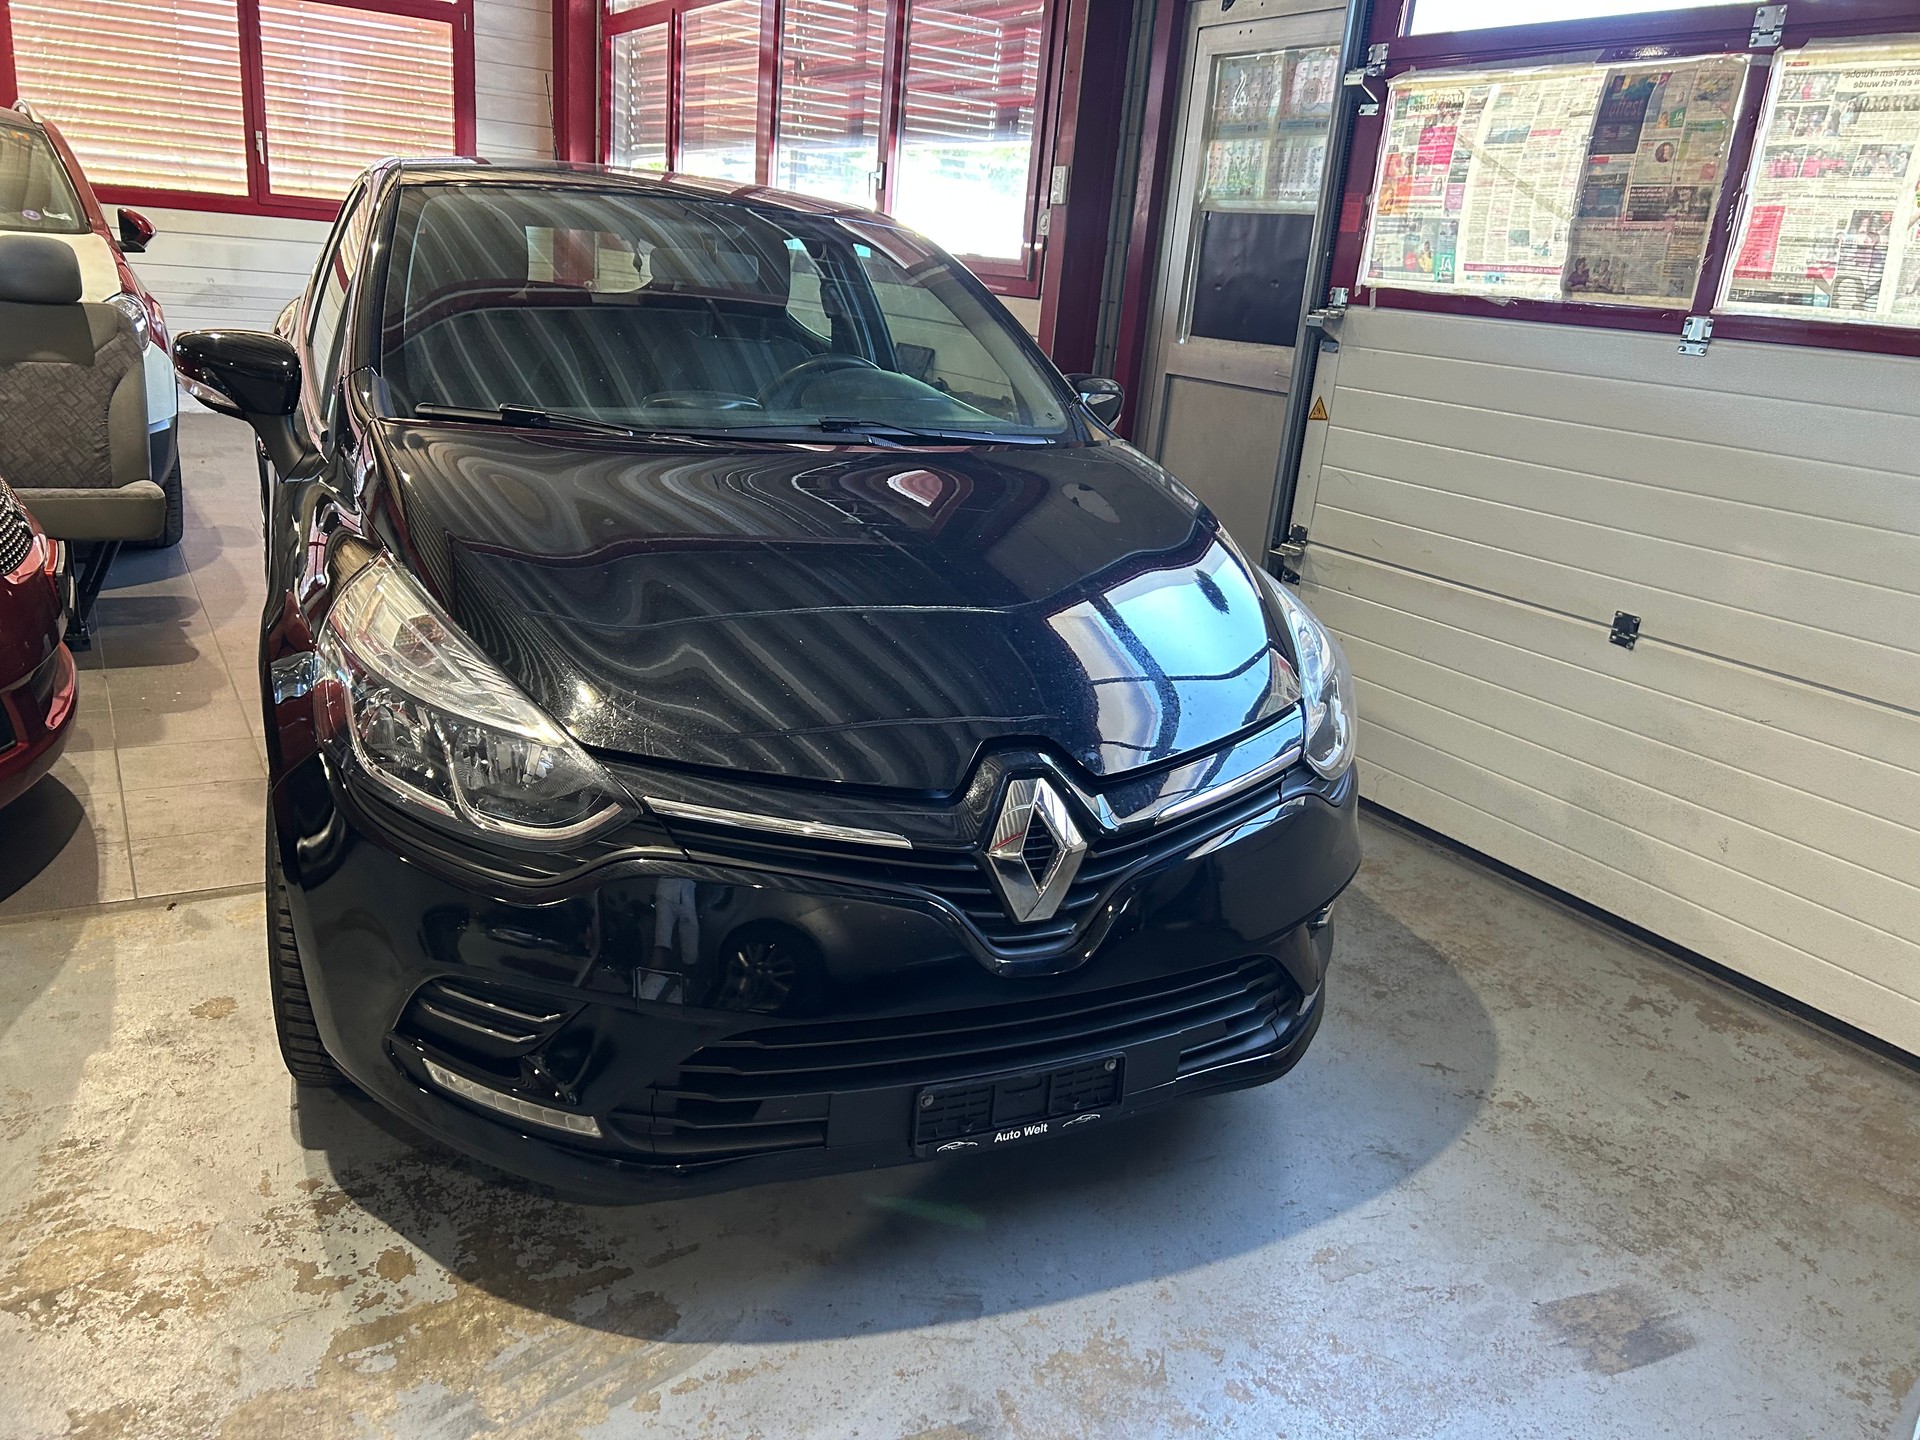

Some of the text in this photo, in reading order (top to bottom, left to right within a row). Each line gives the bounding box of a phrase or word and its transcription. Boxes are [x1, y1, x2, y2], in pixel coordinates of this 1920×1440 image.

[1438, 257, 1453, 271] JA
[995, 1123, 1048, 1143] Auto Welt
